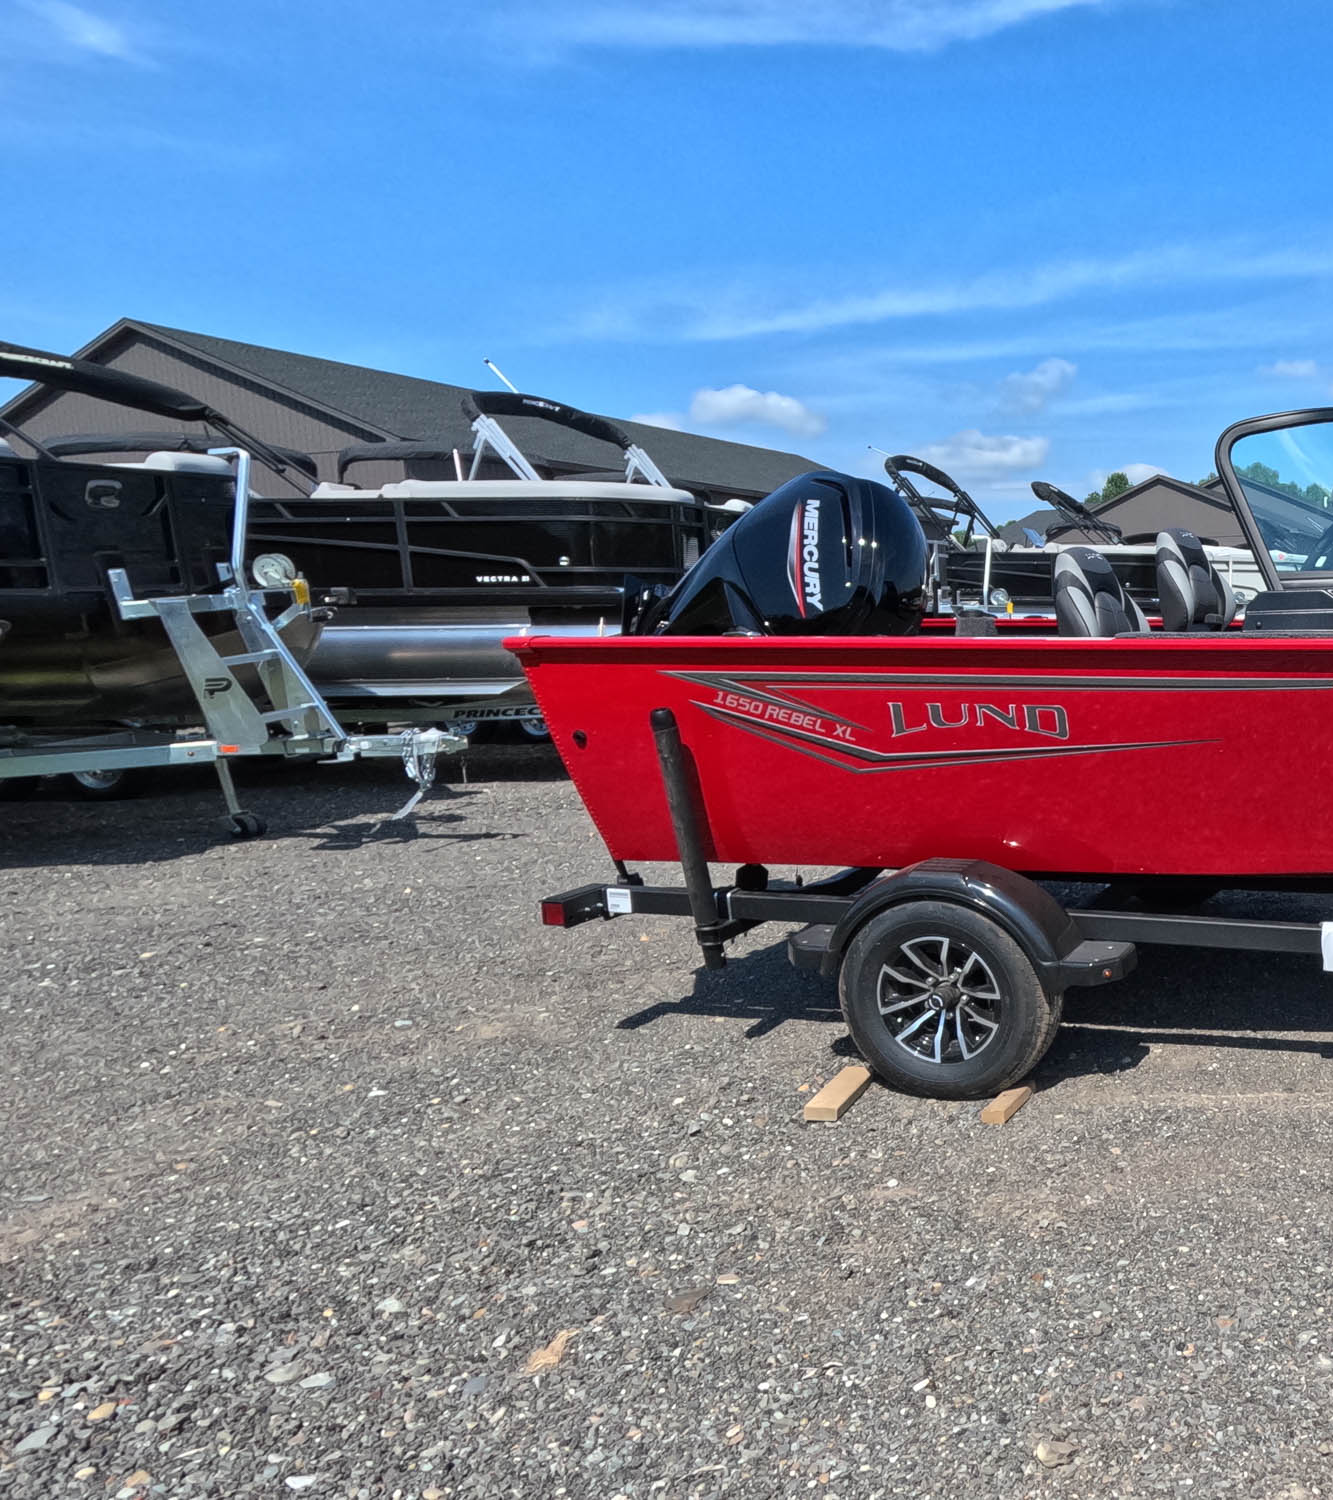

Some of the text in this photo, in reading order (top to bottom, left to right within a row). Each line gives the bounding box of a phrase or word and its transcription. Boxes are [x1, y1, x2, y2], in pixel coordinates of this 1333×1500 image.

[802, 498, 824, 612] MERCURY
[475, 575, 519, 583] VECTRA
[713, 691, 857, 741] 1650 REBEL XL
[886, 701, 1070, 741] LUND
